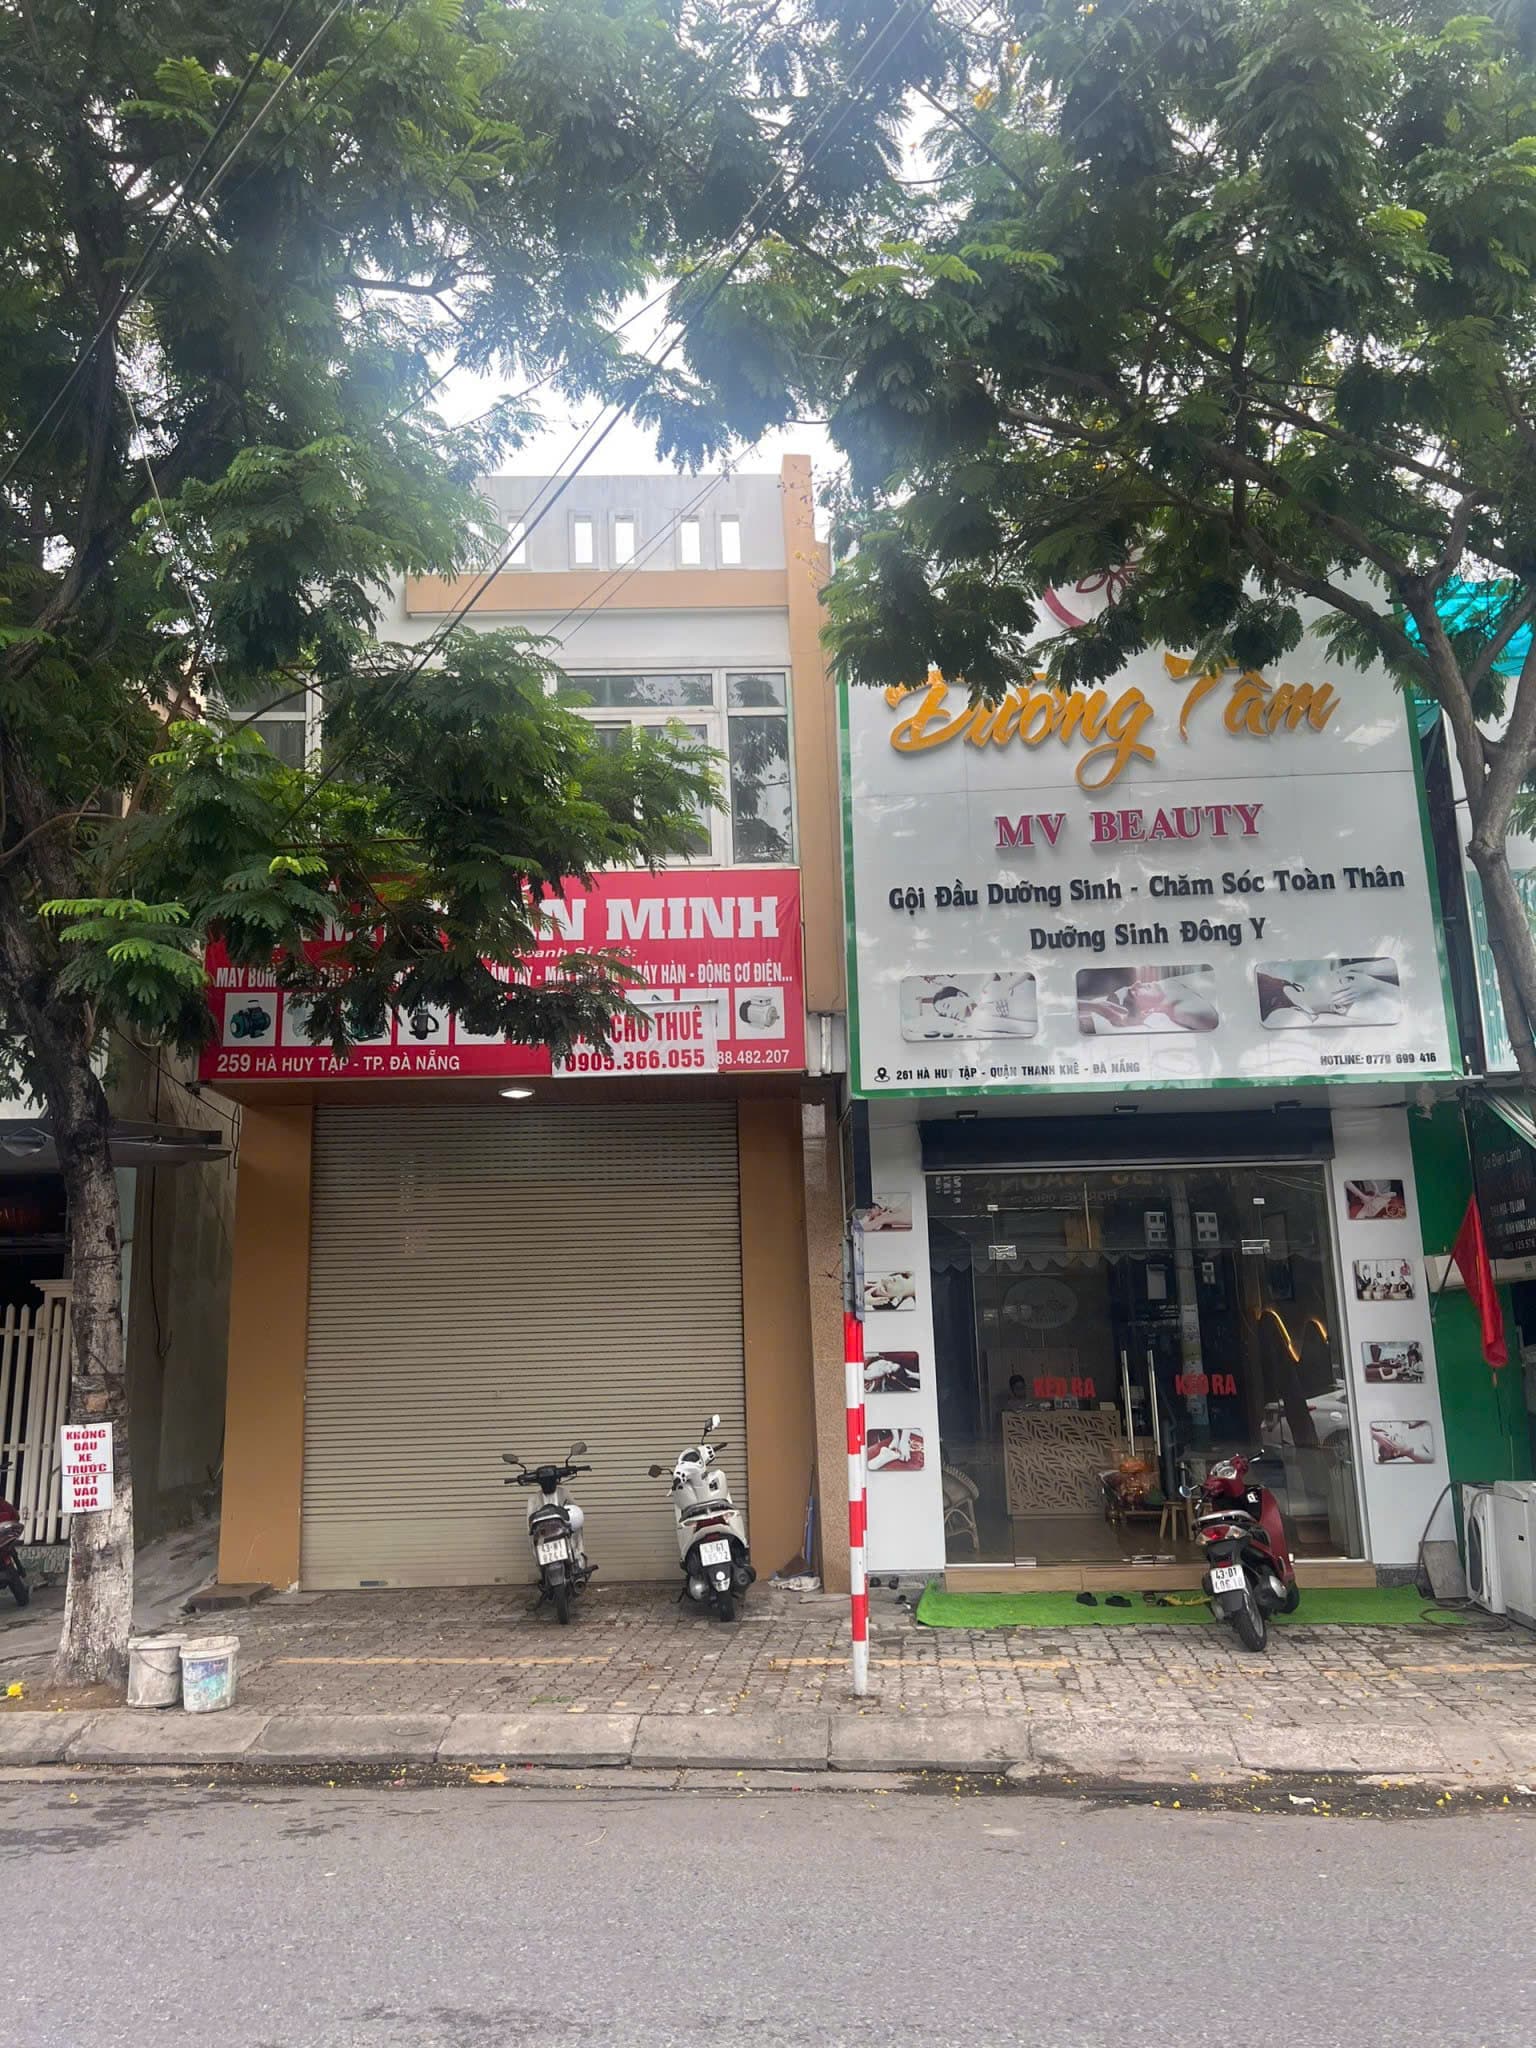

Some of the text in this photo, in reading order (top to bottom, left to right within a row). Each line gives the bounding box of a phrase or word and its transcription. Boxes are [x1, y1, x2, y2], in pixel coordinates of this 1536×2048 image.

[1164, 651, 1340, 742] Tâm
[995, 803, 1263, 848] MV BEAUTY
[889, 886, 925, 916] Gội
[935, 878, 979, 907] Đầu
[987, 880, 1062, 908] Dưỡng
[1069, 878, 1122, 901] Sinh
[1150, 873, 1214, 897] Chăm
[1222, 869, 1265, 894] Sóc
[1273, 867, 1336, 892] Toàn
[1343, 865, 1405, 889] Thân
[605, 896, 780, 941] MINH
[1030, 917, 1266, 952] Dưỡng Sinh Đông Y
[661, 959, 687, 984] HÀN
[698, 959, 732, 988] ĐỘNG
[734, 961, 751, 984] CƠ
[654, 1004, 704, 1042] THUÊ
[217, 1053, 251, 1073] 259
[256, 1053, 277, 1073] HÀ
[282, 1056, 314, 1073] HUY
[363, 1056, 385, 1071] TP.
[390, 1051, 411, 1071] ĐÀ
[415, 1049, 460, 1071] NẴNG
[565, 1049, 705, 1073] 0905.366.055
[896, 1068, 913, 1080] 261
[917, 1066, 930, 1080] HÀ
[958, 1065, 977, 1081] TẬP
[1021, 1064, 1055, 1077] THANH
[1071, 1376, 1097, 1398] RA
[1212, 1373, 1237, 1395] RA
